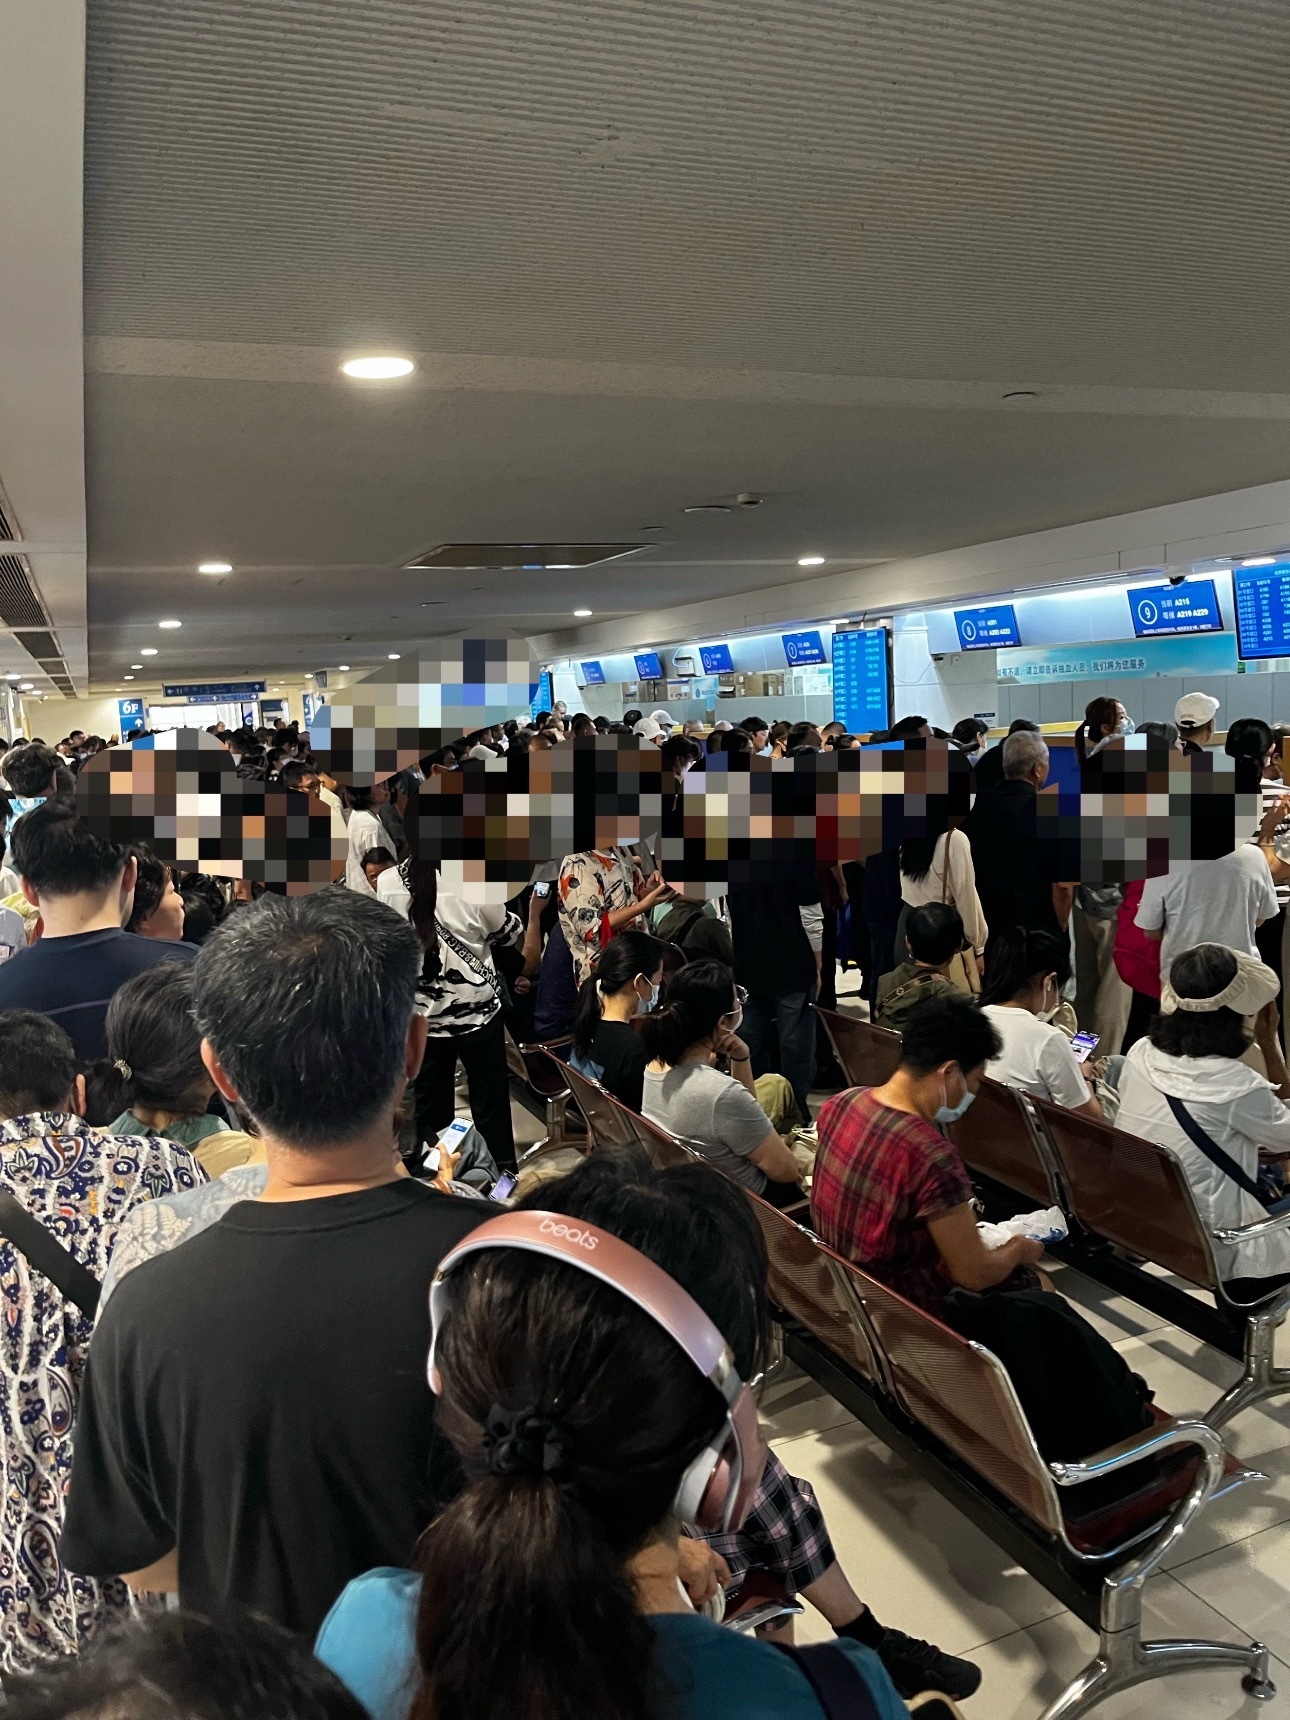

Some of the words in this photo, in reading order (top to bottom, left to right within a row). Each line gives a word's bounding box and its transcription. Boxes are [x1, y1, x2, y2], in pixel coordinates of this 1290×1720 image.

[1174, 597, 1190, 607] A215
[1144, 606, 1151, 619] 9
[122, 700, 139, 715] 6F
[539, 1217, 600, 1251] beats
